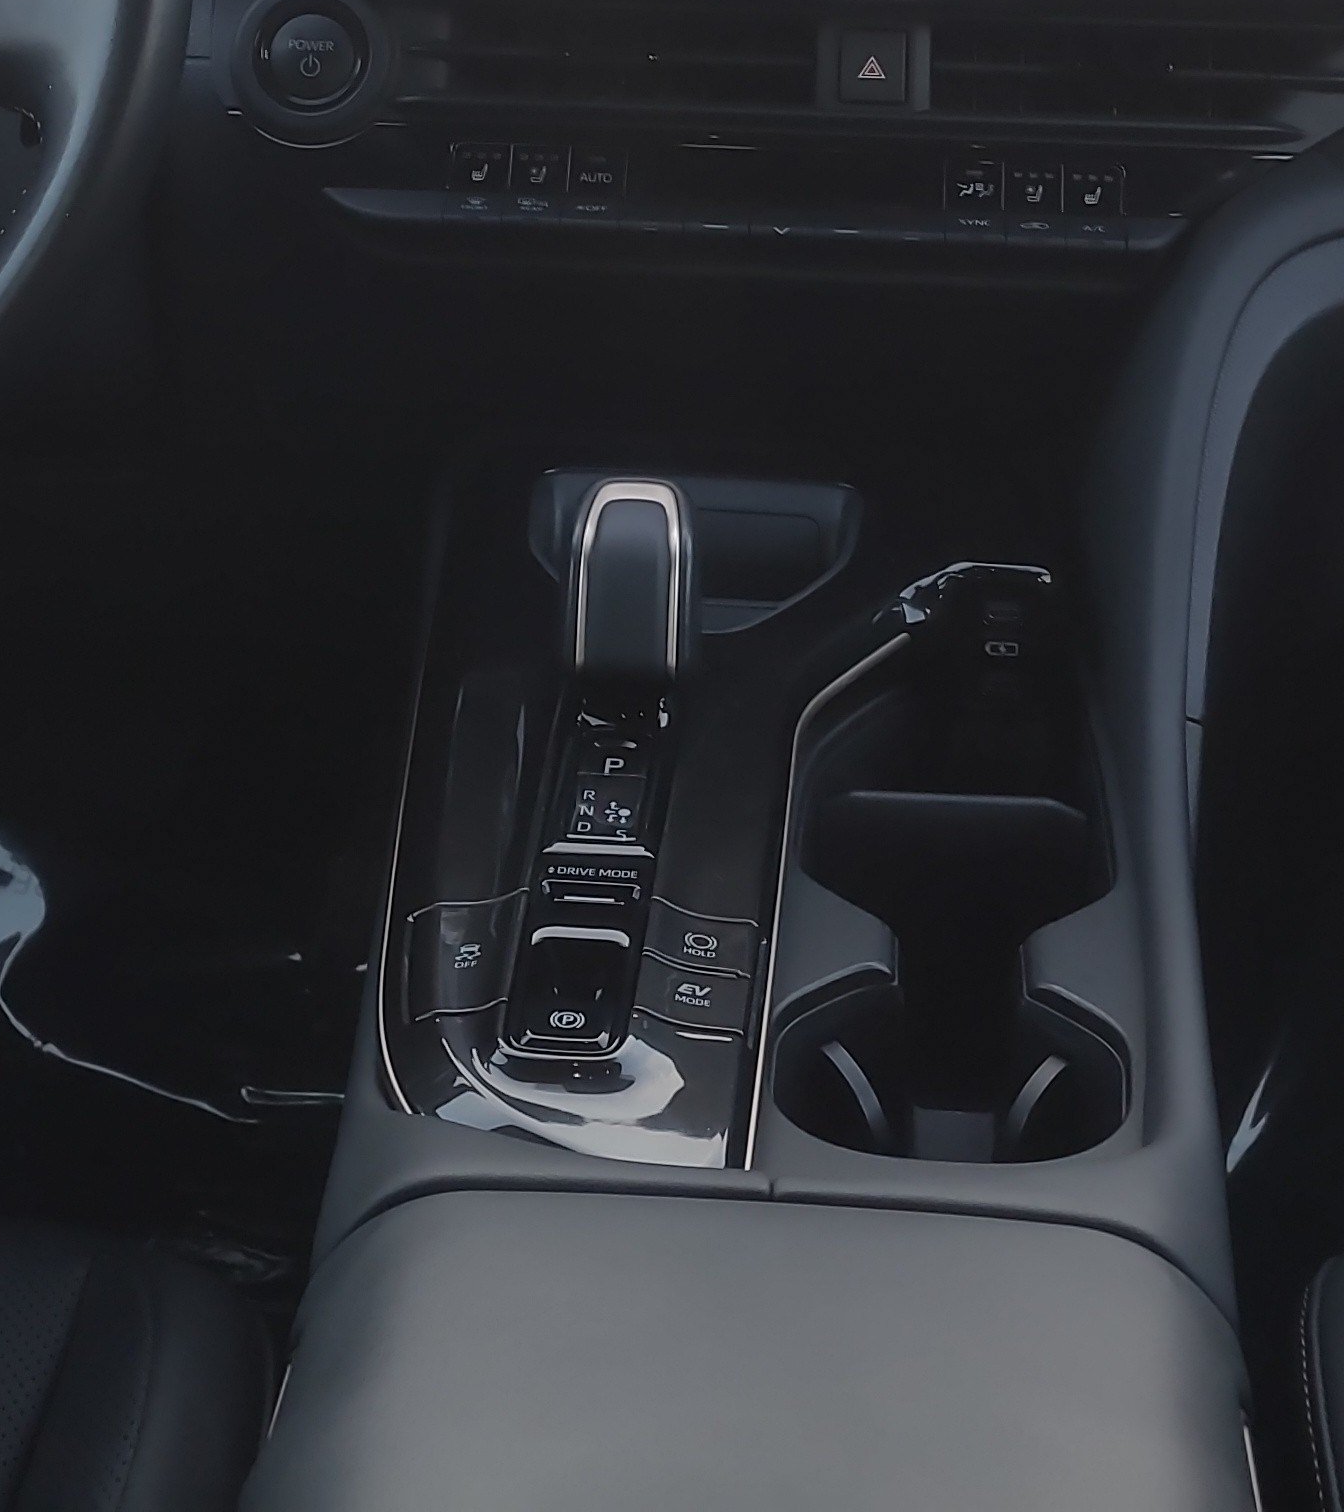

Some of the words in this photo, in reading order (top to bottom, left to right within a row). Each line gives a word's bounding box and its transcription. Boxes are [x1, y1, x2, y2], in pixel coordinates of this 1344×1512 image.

[287, 38, 334, 52] POWER
[579, 171, 613, 184] AUTO
[604, 757, 625, 775] P
[582, 789, 596, 802] R
[579, 804, 595, 817] N
[576, 821, 592, 834] D
[556, 866, 596, 877] DRIVE
[599, 868, 638, 879] MODE
[683, 945, 716, 959] HOLD
[454, 960, 478, 969] OFF
[676, 982, 712, 997] EV
[674, 994, 711, 1007] MODE
